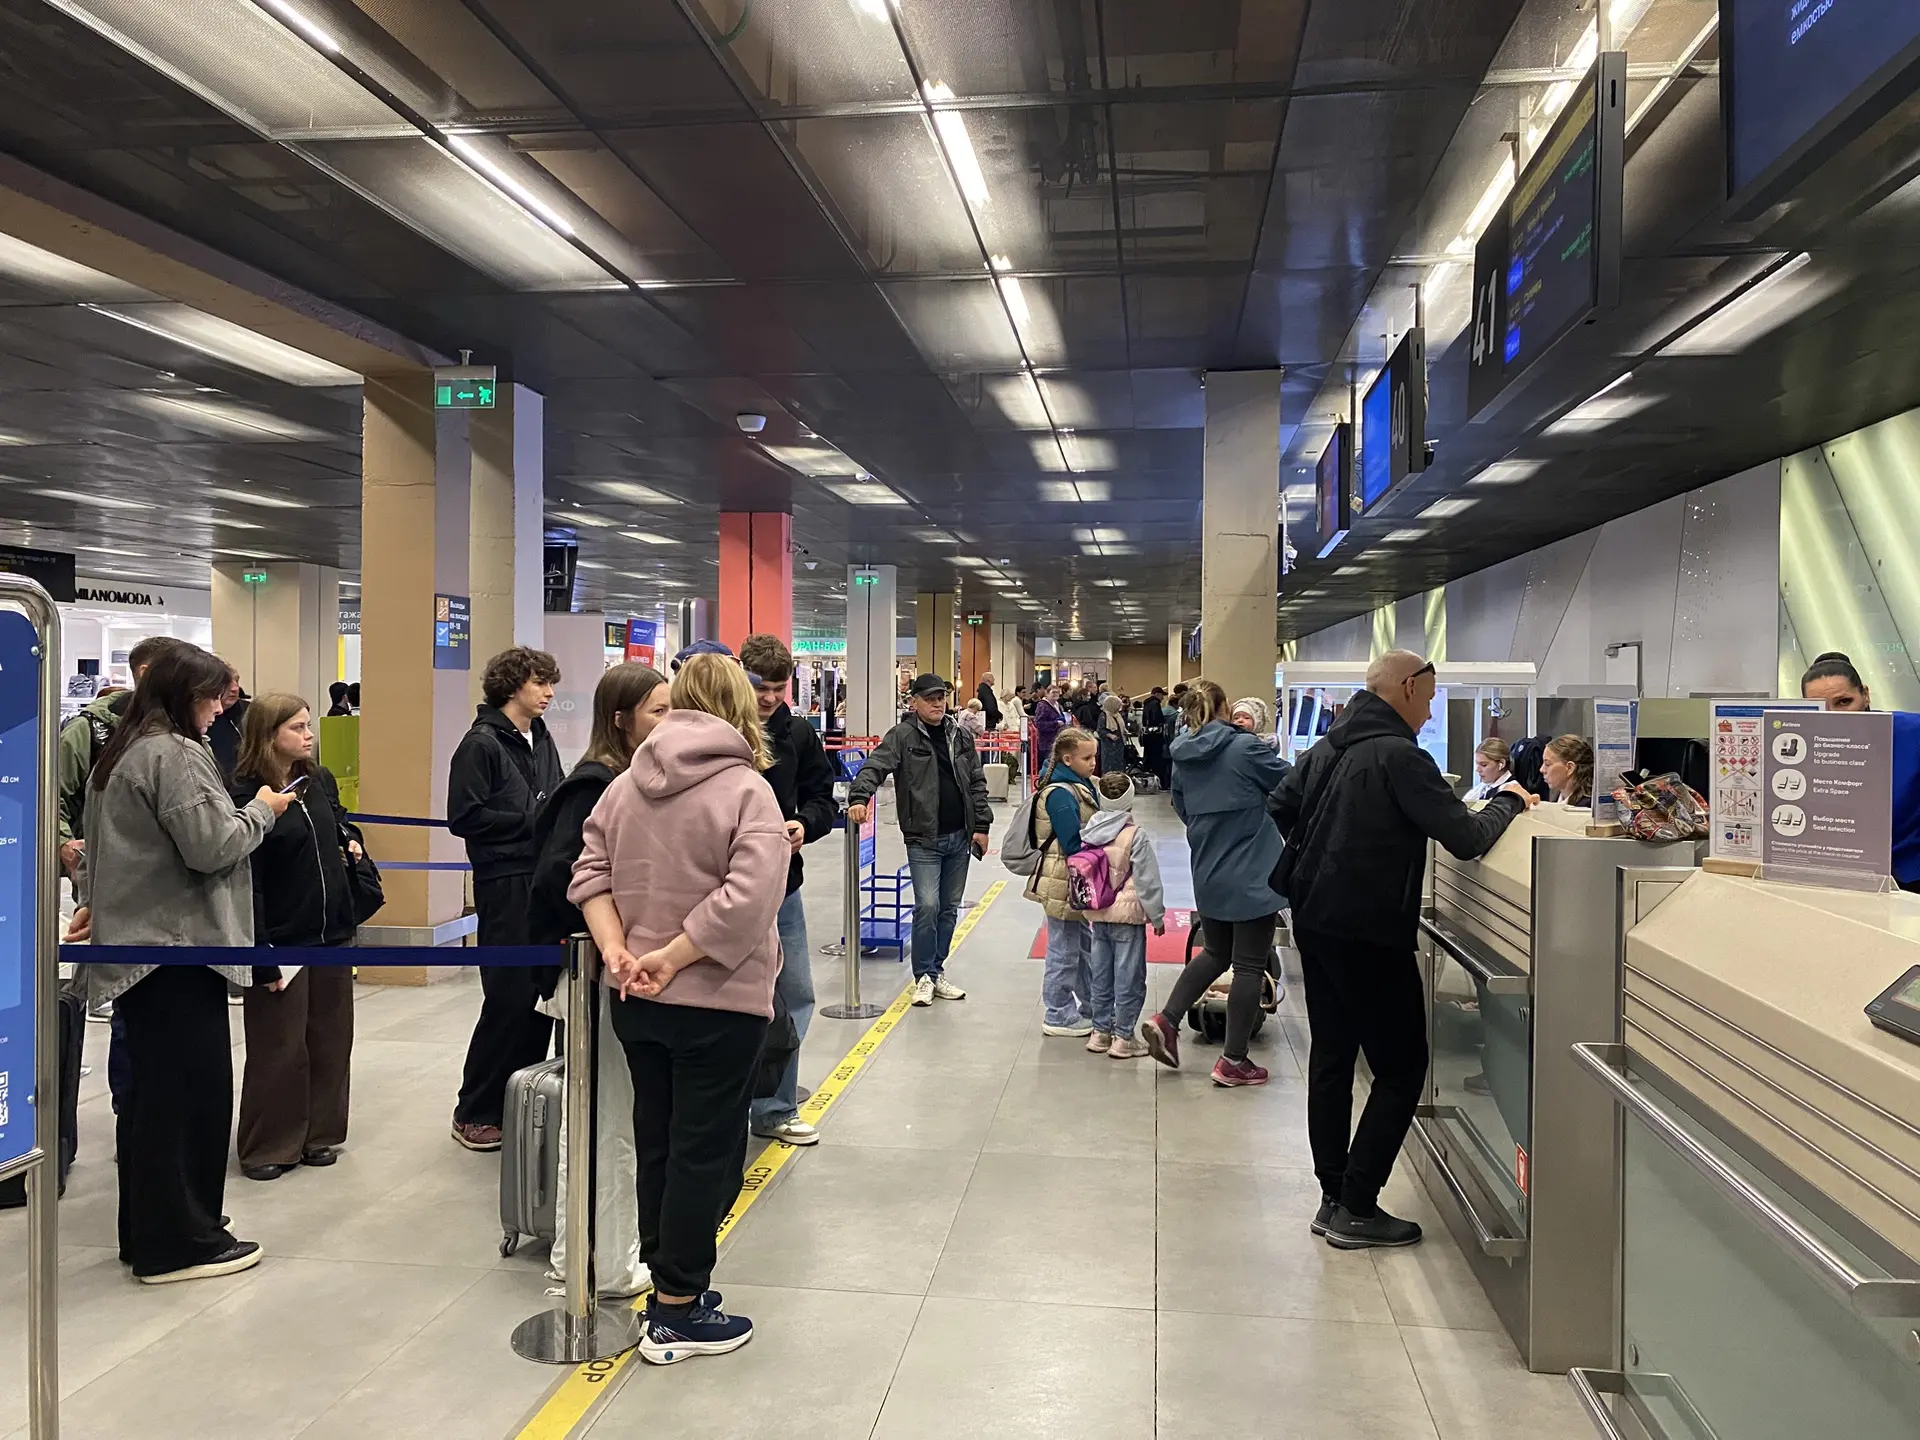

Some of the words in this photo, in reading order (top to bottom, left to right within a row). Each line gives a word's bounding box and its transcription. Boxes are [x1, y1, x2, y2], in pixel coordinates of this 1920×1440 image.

[1791, 0, 1811, 20] жид
[1791, 0, 1835, 44] емкостью
[1473, 269, 1497, 366] 41
[1392, 382, 1405, 450] 40
[1813, 735, 1851, 743] Повышение
[1833, 779, 1863, 787] Комфорт
[1829, 788, 1850, 796] Space
[1812, 815, 1834, 823] Выбор
[1828, 825, 1856, 833] selection
[834, 1065, 855, 1081] STOP
[806, 1092, 833, 1111] СТОП
[742, 1166, 772, 1191] СТОП
